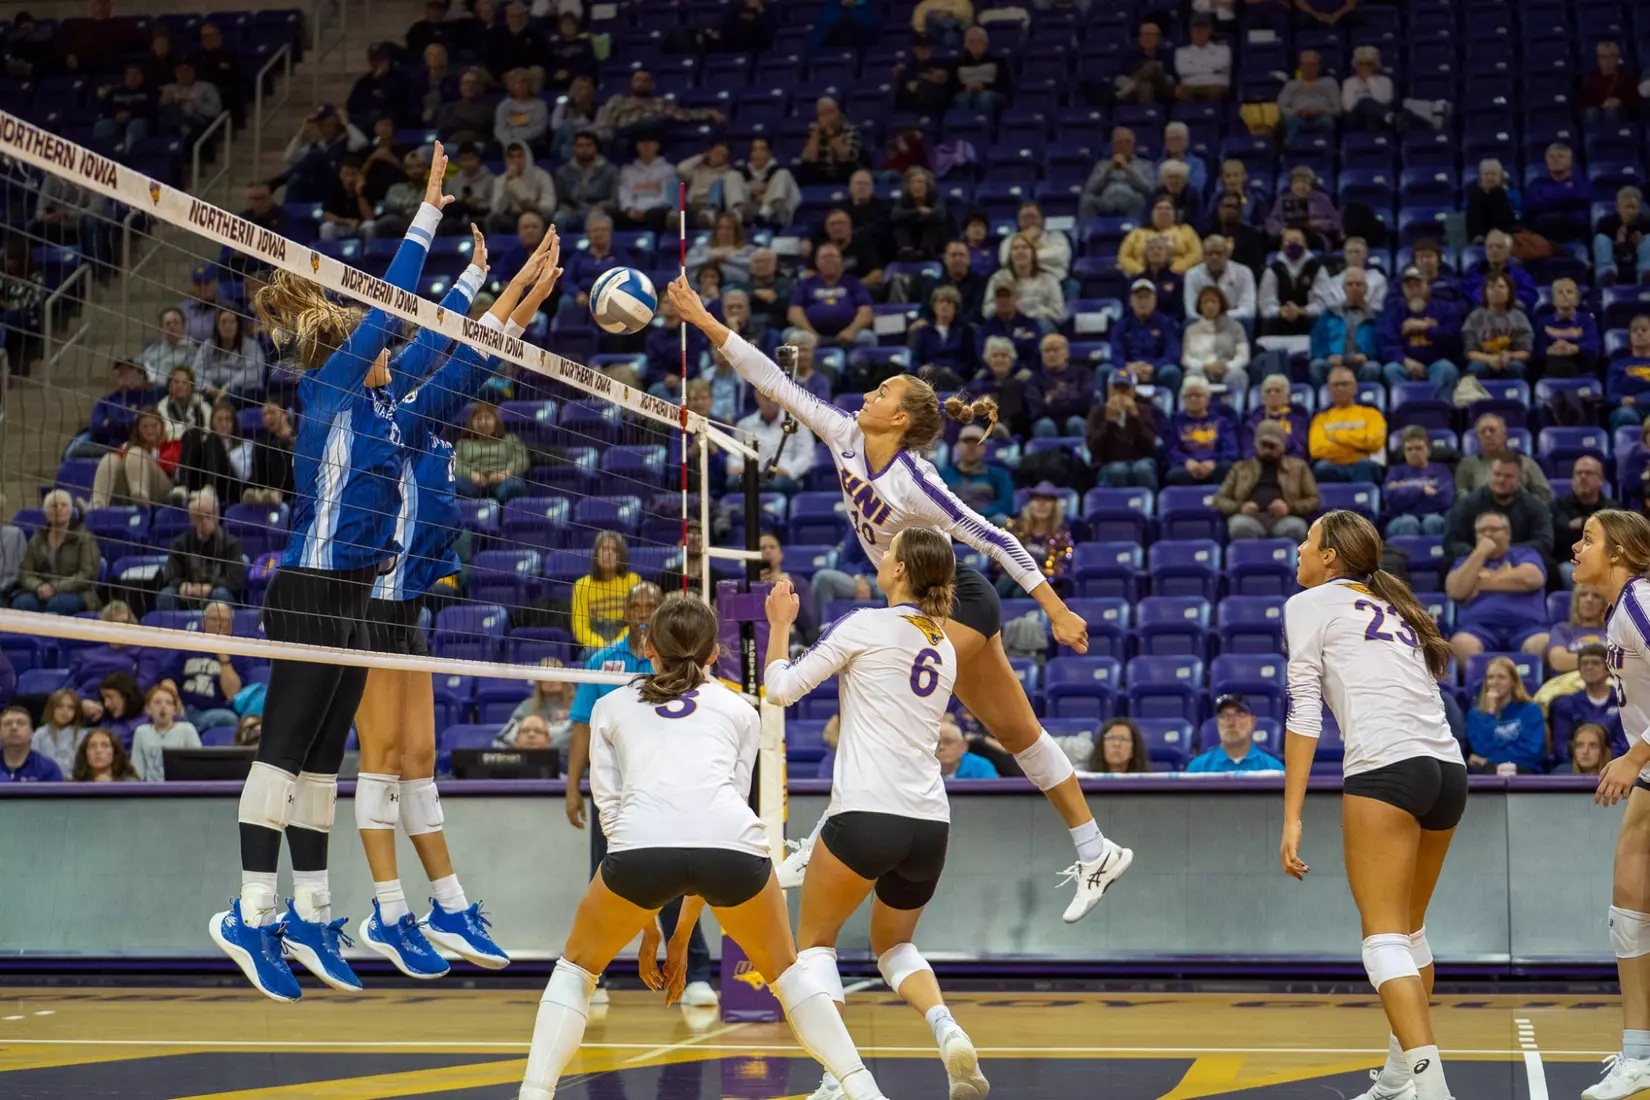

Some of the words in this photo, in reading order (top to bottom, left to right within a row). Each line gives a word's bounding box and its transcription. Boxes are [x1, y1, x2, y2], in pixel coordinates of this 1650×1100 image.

[78, 154, 118, 189] IOWA
[189, 199, 254, 247] NORTHERN
[257, 229, 287, 262] IOWA
[341, 266, 394, 307] NORTHERN
[395, 287, 419, 316] IOWA
[462, 318, 503, 351] NORTHERN
[505, 336, 525, 361] IOWA
[560, 359, 595, 387] NORTHERN
[595, 373, 611, 395] IOWA
[640, 392, 668, 416] NORTHERN
[840, 468, 894, 526] UNI
[1354, 598, 1419, 649] 23
[748, 639, 757, 676] SPORTS
[909, 647, 943, 698] 6
[655, 689, 700, 719] 3
